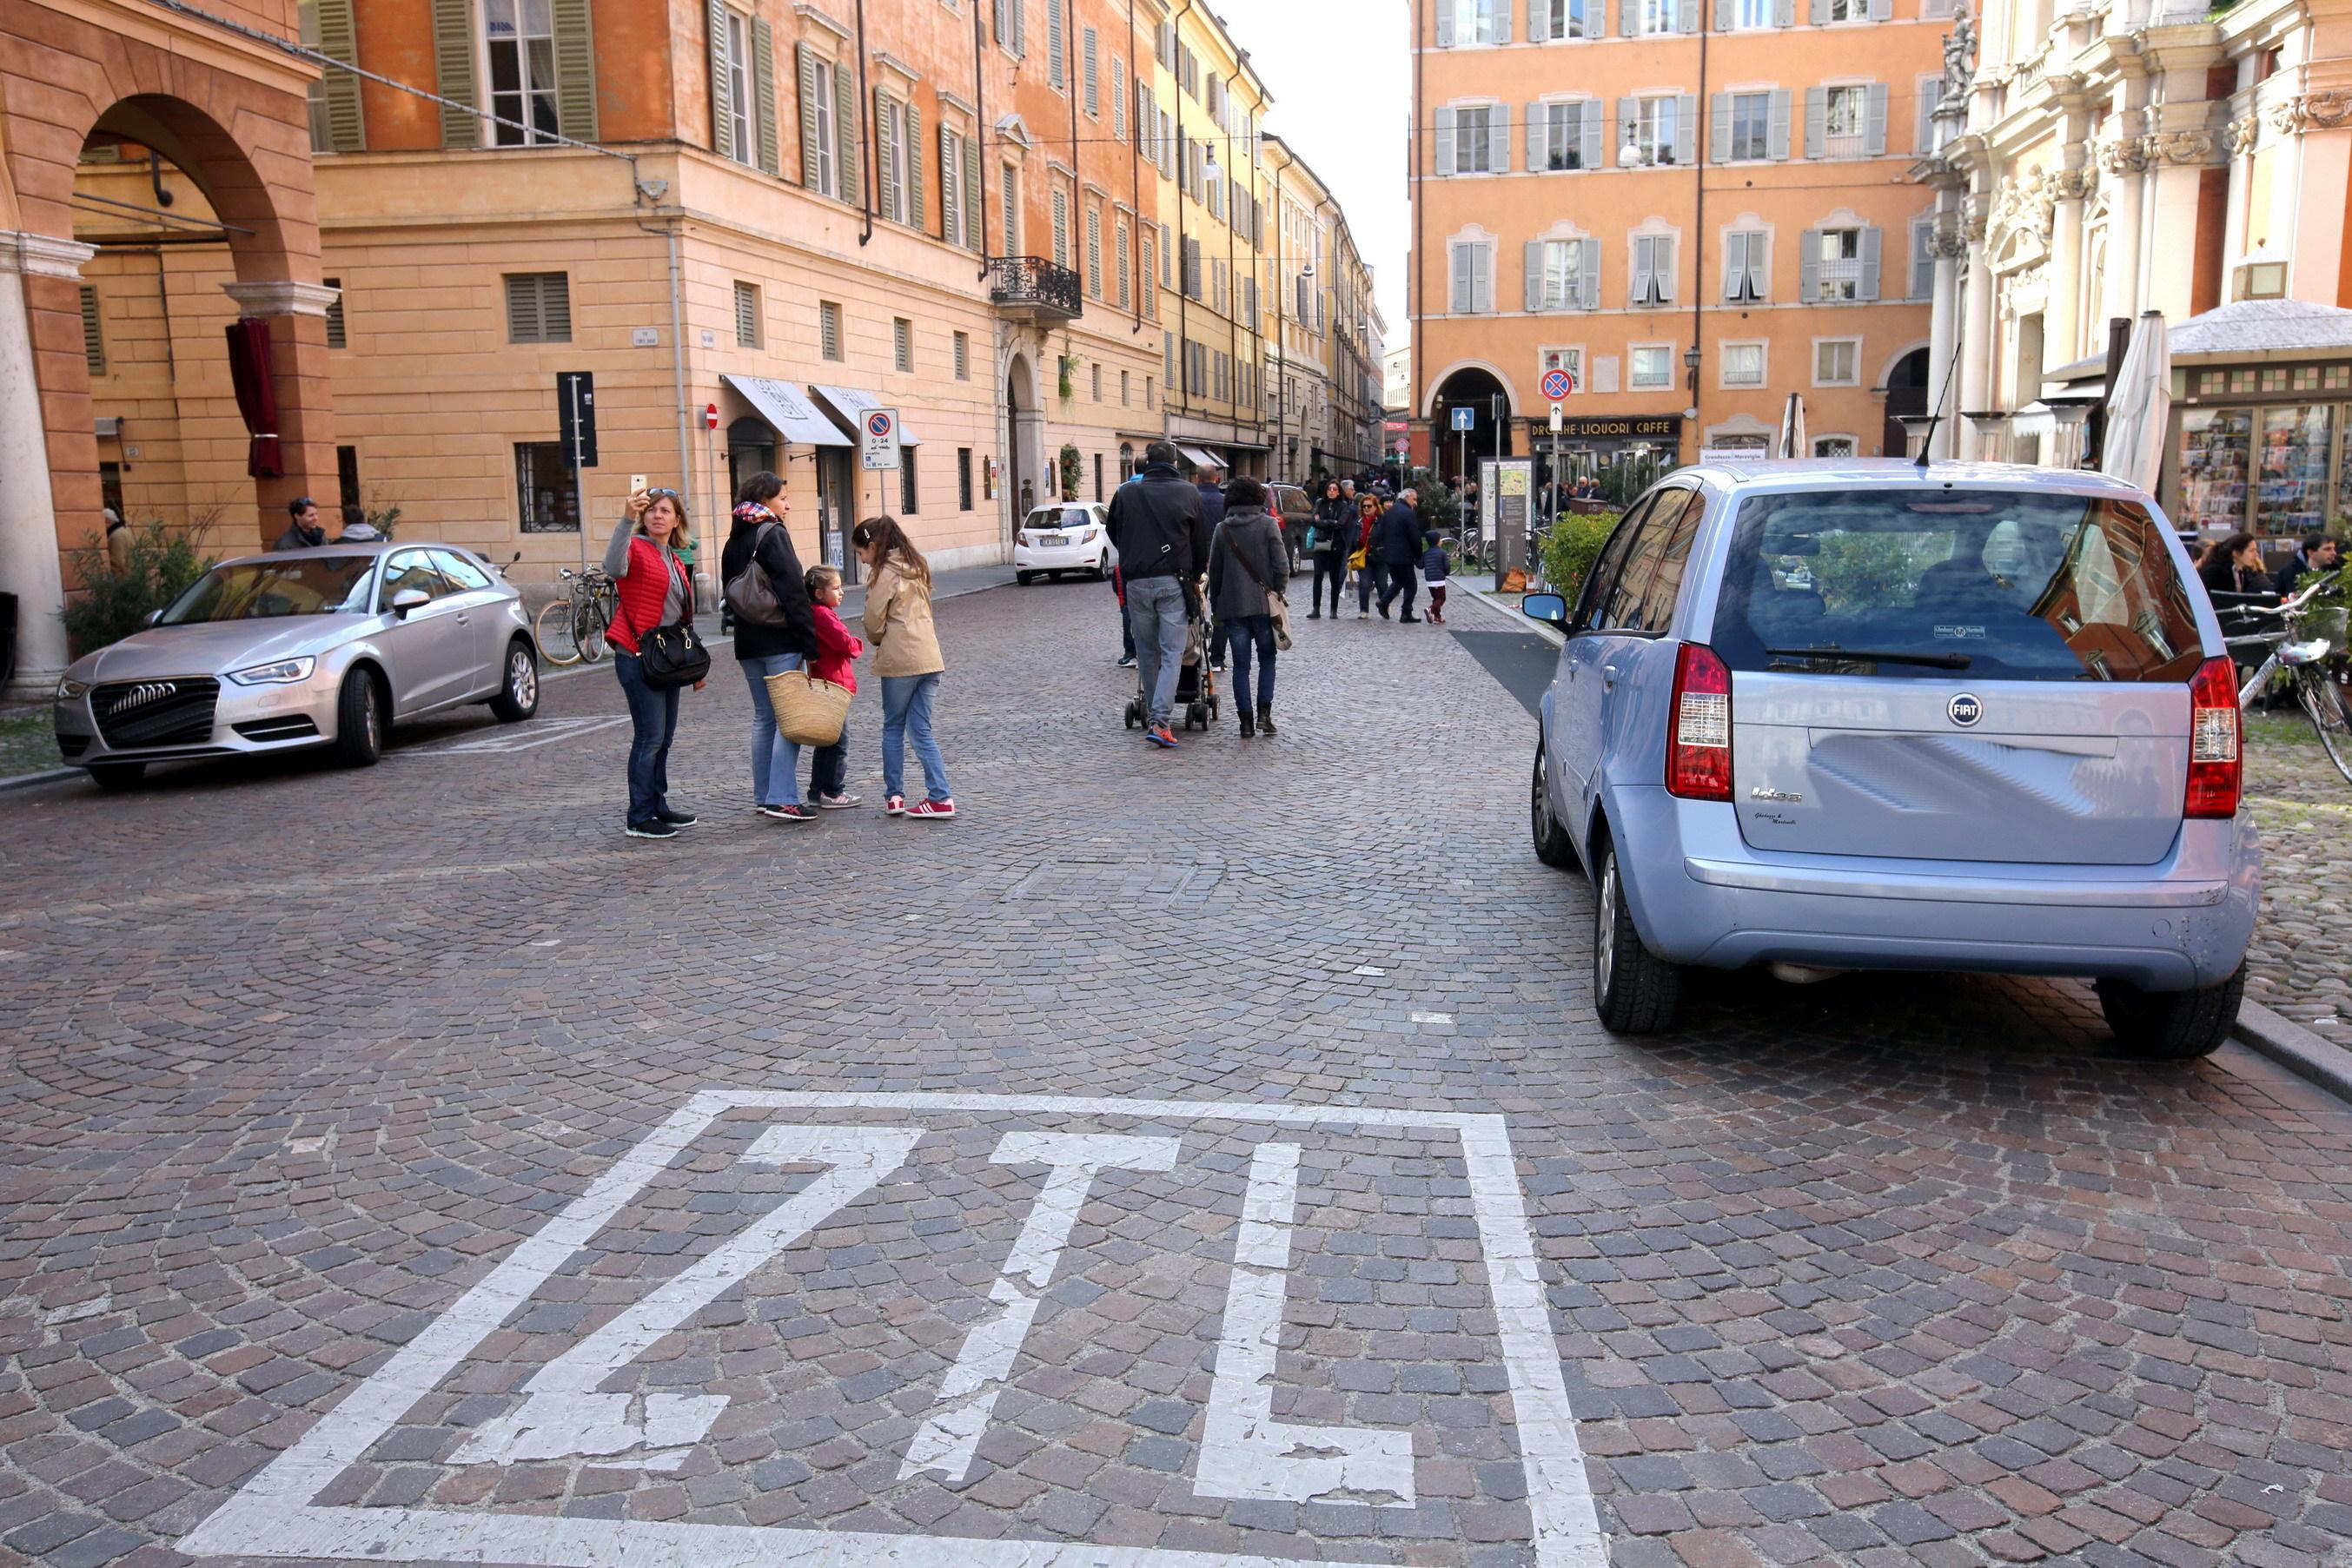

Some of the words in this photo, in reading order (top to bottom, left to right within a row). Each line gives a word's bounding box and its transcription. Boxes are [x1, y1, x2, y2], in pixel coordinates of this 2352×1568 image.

[1532, 424, 1576, 435] DROHE
[1581, 423, 1629, 434] LIQUORI
[1637, 421, 1669, 433] CAFFE
[1954, 705, 1977, 716] FIAT
[1752, 786, 1803, 801] Idea
[447, 1125, 1415, 1510] ZTL
